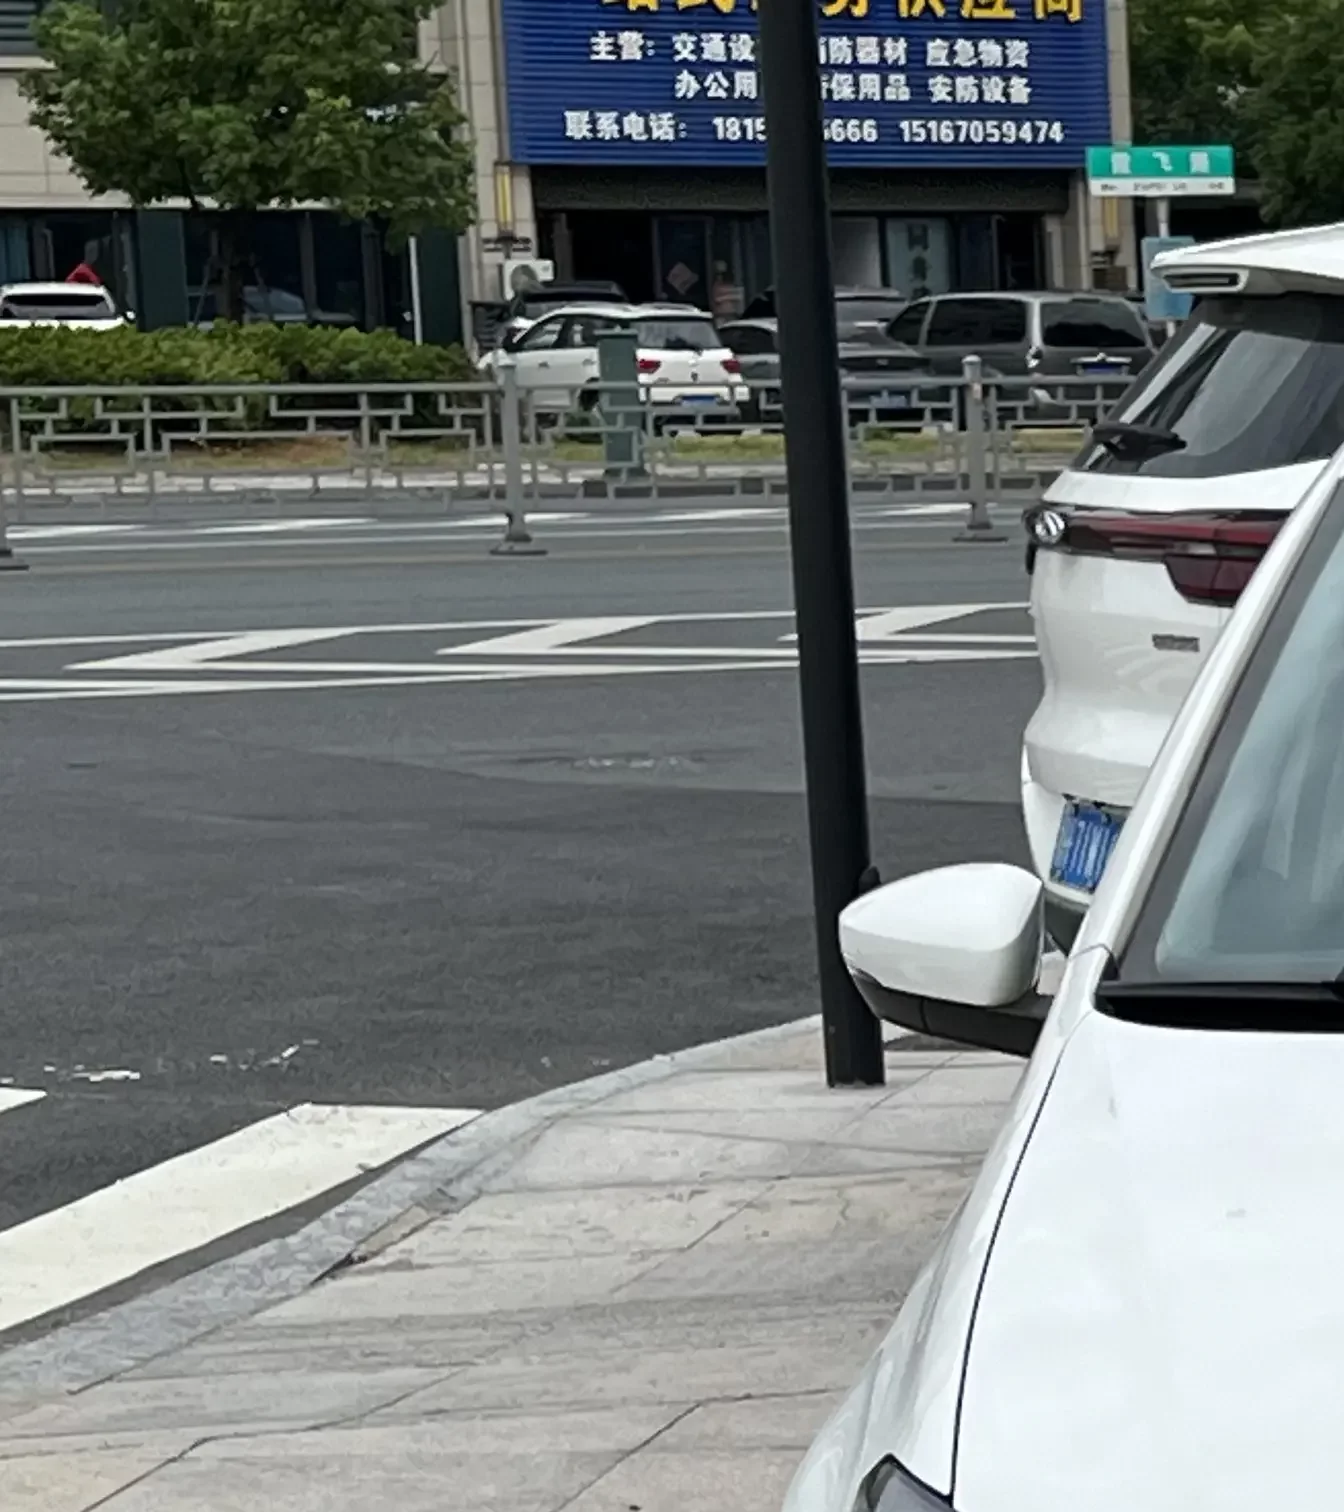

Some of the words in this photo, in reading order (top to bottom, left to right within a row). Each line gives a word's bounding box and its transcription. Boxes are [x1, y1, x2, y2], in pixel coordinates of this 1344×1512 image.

[672, 32, 757, 62] 交通设
[926, 38, 1029, 68] 应急物资
[674, 70, 758, 99] 办公用
[821, 73, 910, 101] 保用品
[927, 75, 1032, 104] 安防设备
[564, 110, 688, 141] 联系电话：
[900, 120, 1065, 143] 15167059474
